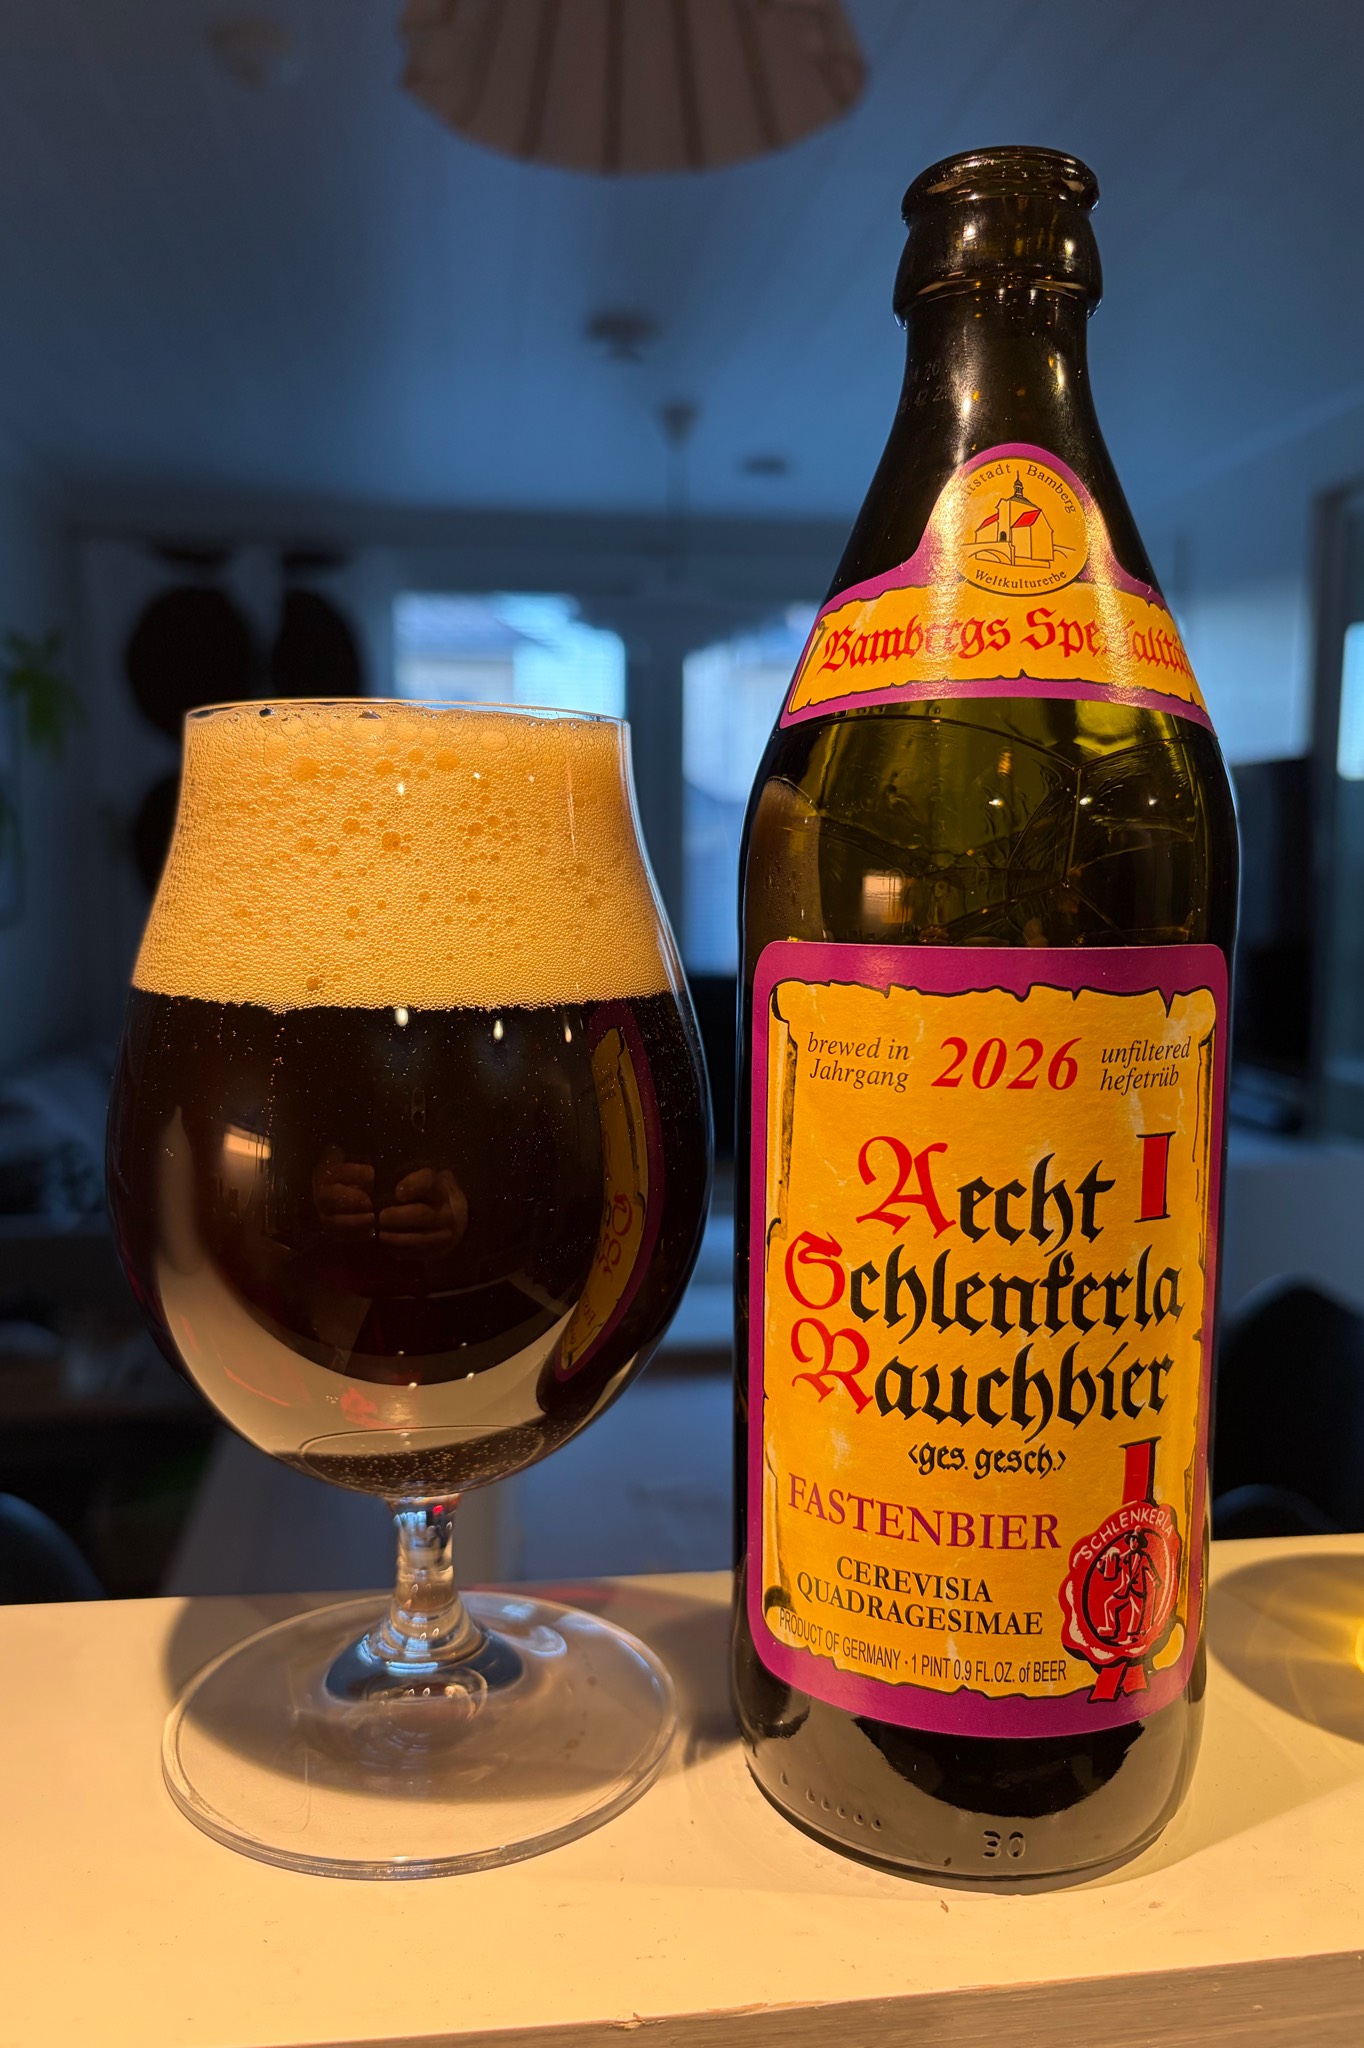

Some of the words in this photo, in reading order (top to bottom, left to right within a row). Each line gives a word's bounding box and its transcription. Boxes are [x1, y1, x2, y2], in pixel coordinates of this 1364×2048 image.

[1026, 464, 1077, 514] Bamberg
[975, 569, 1067, 589] Weltkulturerbe
[817, 614, 1011, 675] Bambergs
[807, 1032, 880, 1060] brewed
[888, 1038, 910, 1061] in
[931, 1036, 1083, 1091] 2026
[1100, 1036, 1192, 1069] unfiltered
[809, 1058, 909, 1093] Jahrgang
[1100, 1065, 1180, 1096] hefetrüb
[856, 1135, 1116, 1257] Aecht
[784, 1231, 1185, 1344] Schlenkerla
[790, 1317, 1175, 1443] Rauchbier
[788, 1472, 1062, 1550] FASTENBIER
[1080, 1507, 1174, 1561] SCHLENKERLA
[796, 1571, 1043, 1635] QUADRAGESIMAE
[836, 1555, 993, 1603] CEREVISIA
[780, 1607, 823, 1647] PRODUCT
[825, 1630, 840, 1652] OF
[842, 1636, 901, 1670] GERMANY
[911, 1653, 917, 1674] 1
[921, 1654, 951, 1679] PINT
[953, 1659, 972, 1681] 0.9
[1018, 1662, 1031, 1683] of
[1033, 1659, 1067, 1682] BEER
[982, 1830, 1026, 1859] 30
